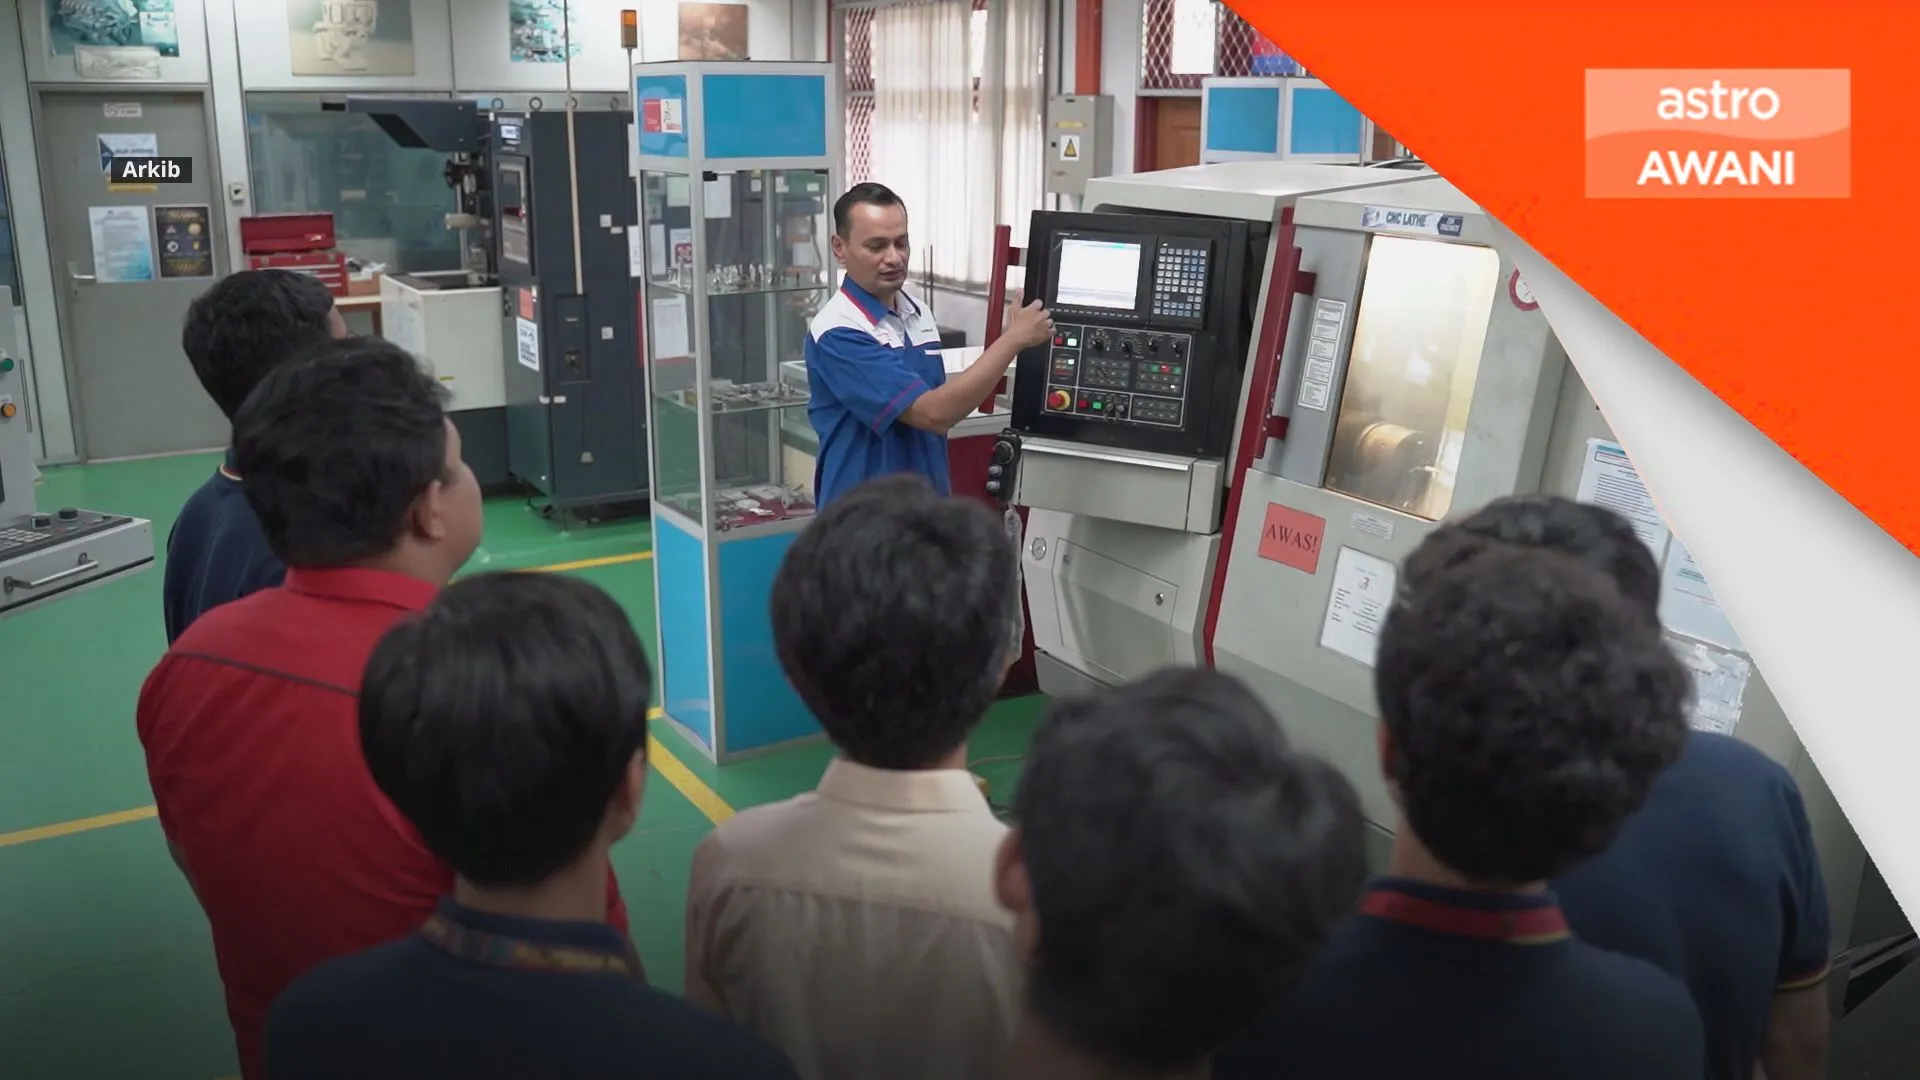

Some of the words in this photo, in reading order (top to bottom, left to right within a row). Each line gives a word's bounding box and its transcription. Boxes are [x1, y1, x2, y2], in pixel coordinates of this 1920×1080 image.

[1386, 211, 1401, 225] CNC
[1403, 213, 1427, 227] LATHE
[1265, 523, 1317, 554] AWAS!
